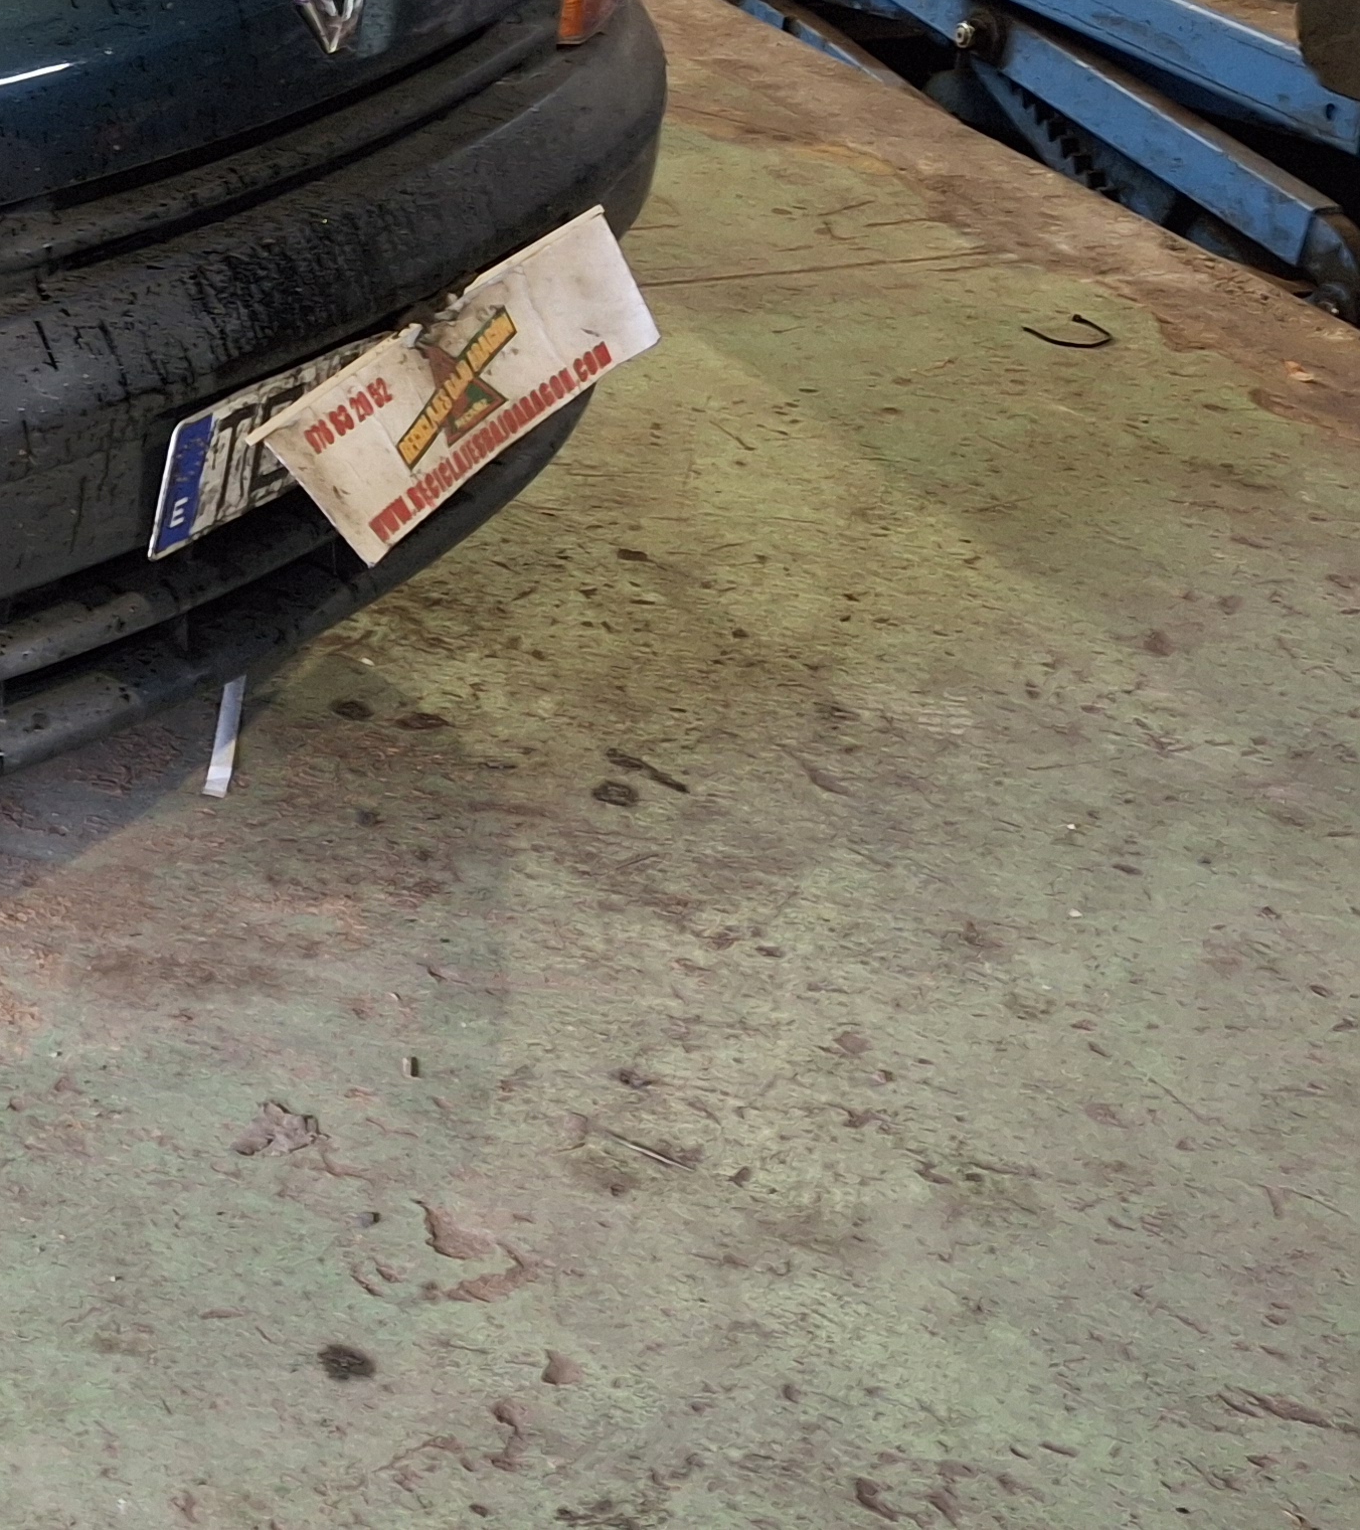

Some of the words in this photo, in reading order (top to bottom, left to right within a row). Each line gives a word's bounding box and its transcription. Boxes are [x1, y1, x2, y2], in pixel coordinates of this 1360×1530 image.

[366, 377, 393, 409] 52
[443, 359, 474, 401] BAJO
[167, 496, 189, 529] E
